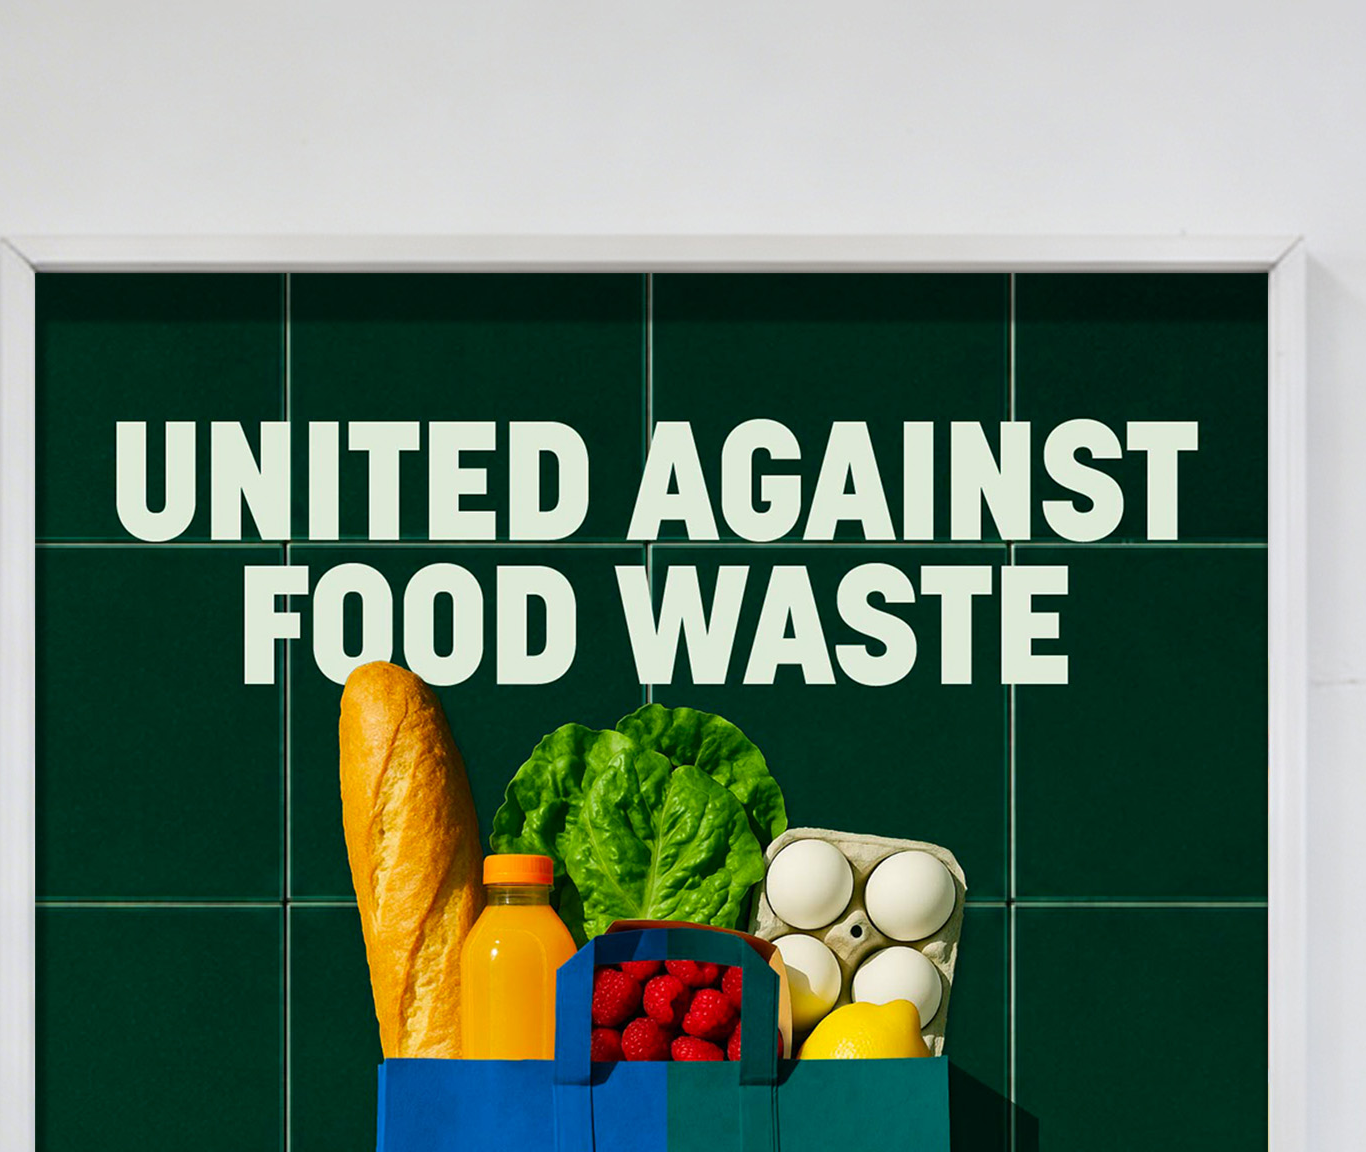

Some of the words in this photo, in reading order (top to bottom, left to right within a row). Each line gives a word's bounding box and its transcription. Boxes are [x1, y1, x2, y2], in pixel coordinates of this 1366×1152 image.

[116, 420, 590, 542] UNITED
[627, 418, 1199, 542] AGAINST
[244, 562, 577, 686] FOOD
[615, 562, 1069, 686] WASTE
